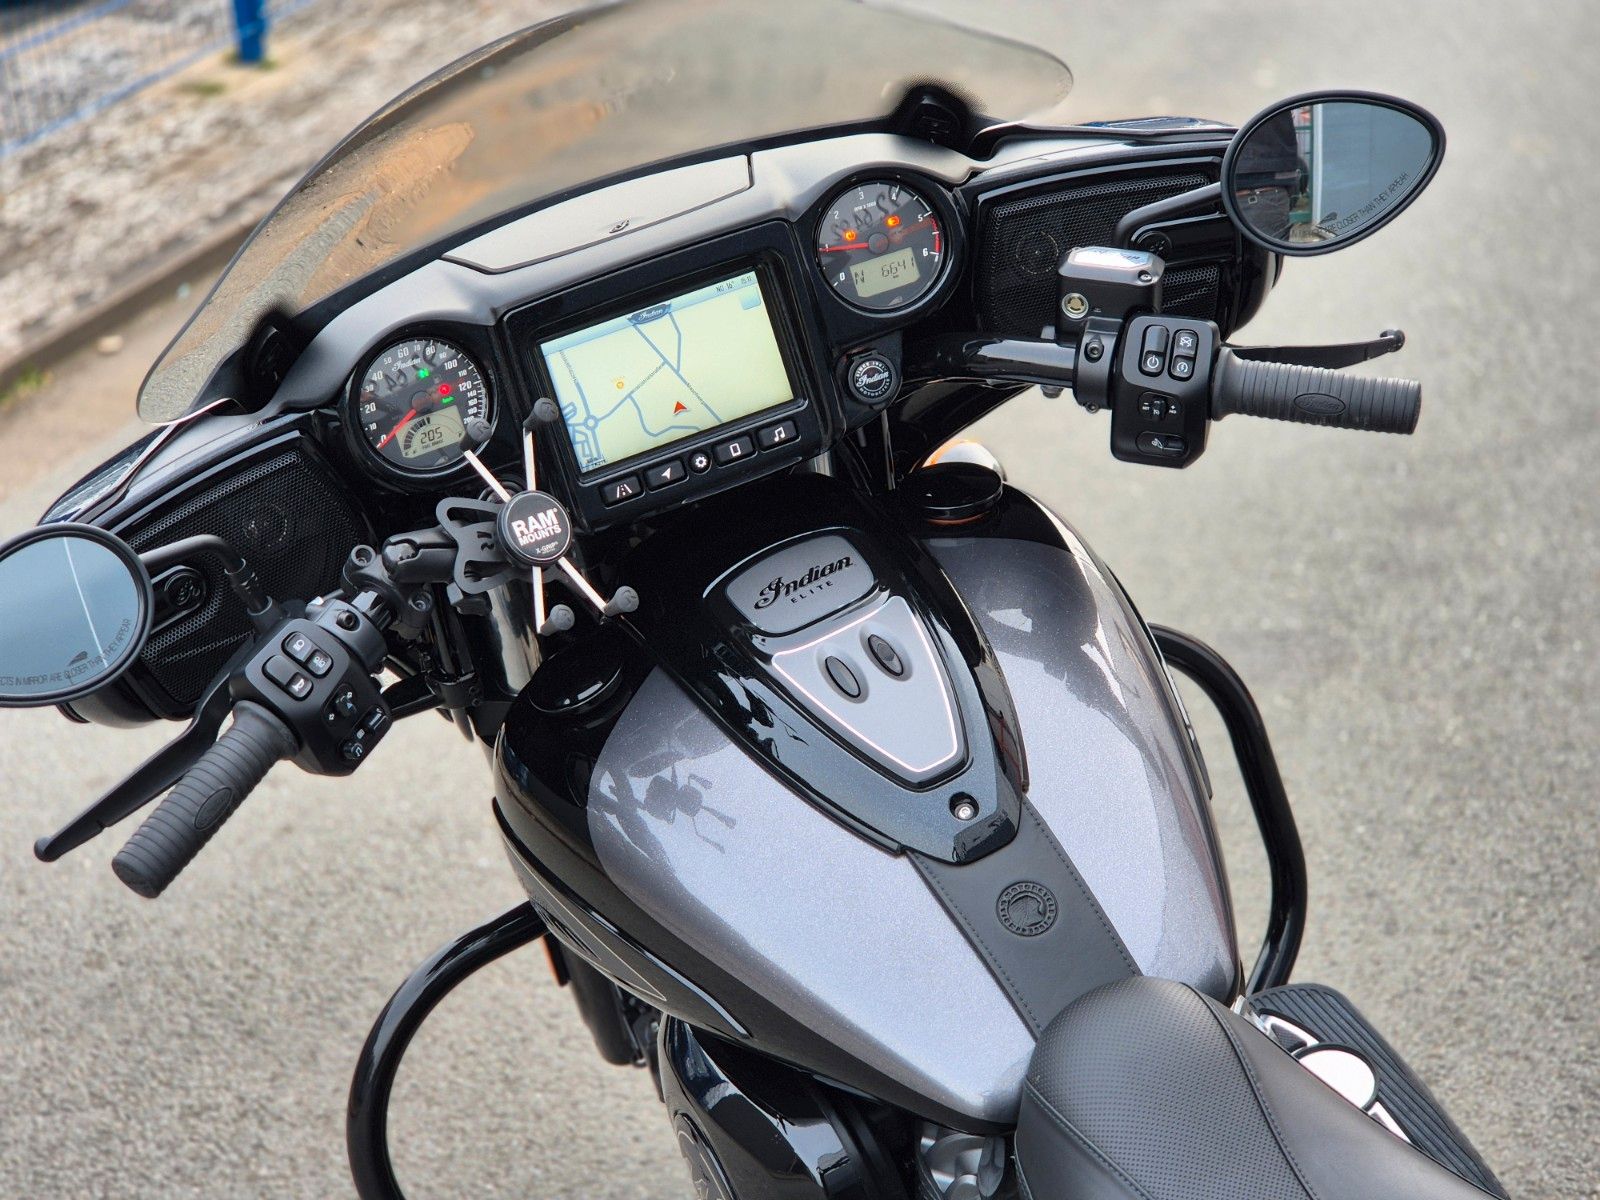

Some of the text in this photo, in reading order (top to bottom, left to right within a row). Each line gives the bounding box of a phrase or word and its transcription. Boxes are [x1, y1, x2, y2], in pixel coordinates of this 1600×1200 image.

[859, 191, 865, 200] 3
[891, 192, 898, 200] 4
[833, 210, 840, 219] 2
[917, 213, 924, 222] 5
[922, 248, 928, 257] 6
[840, 272, 846, 281] 0
[854, 269, 865, 285] N
[397, 346, 409, 359] 60
[425, 345, 436, 356] 80
[444, 359, 458, 371] 100
[372, 370, 384, 381] 40
[856, 371, 889, 387] Indian
[458, 380, 472, 392] 120
[467, 389, 477, 398] 140
[364, 402, 377, 414] 20
[369, 422, 377, 431] 10
[420, 426, 443, 445] 205
[511, 509, 558, 539] RAM
[518, 524, 562, 546] MOUNTS
[753, 556, 854, 610] Indian
[790, 580, 834, 604] ELITE
